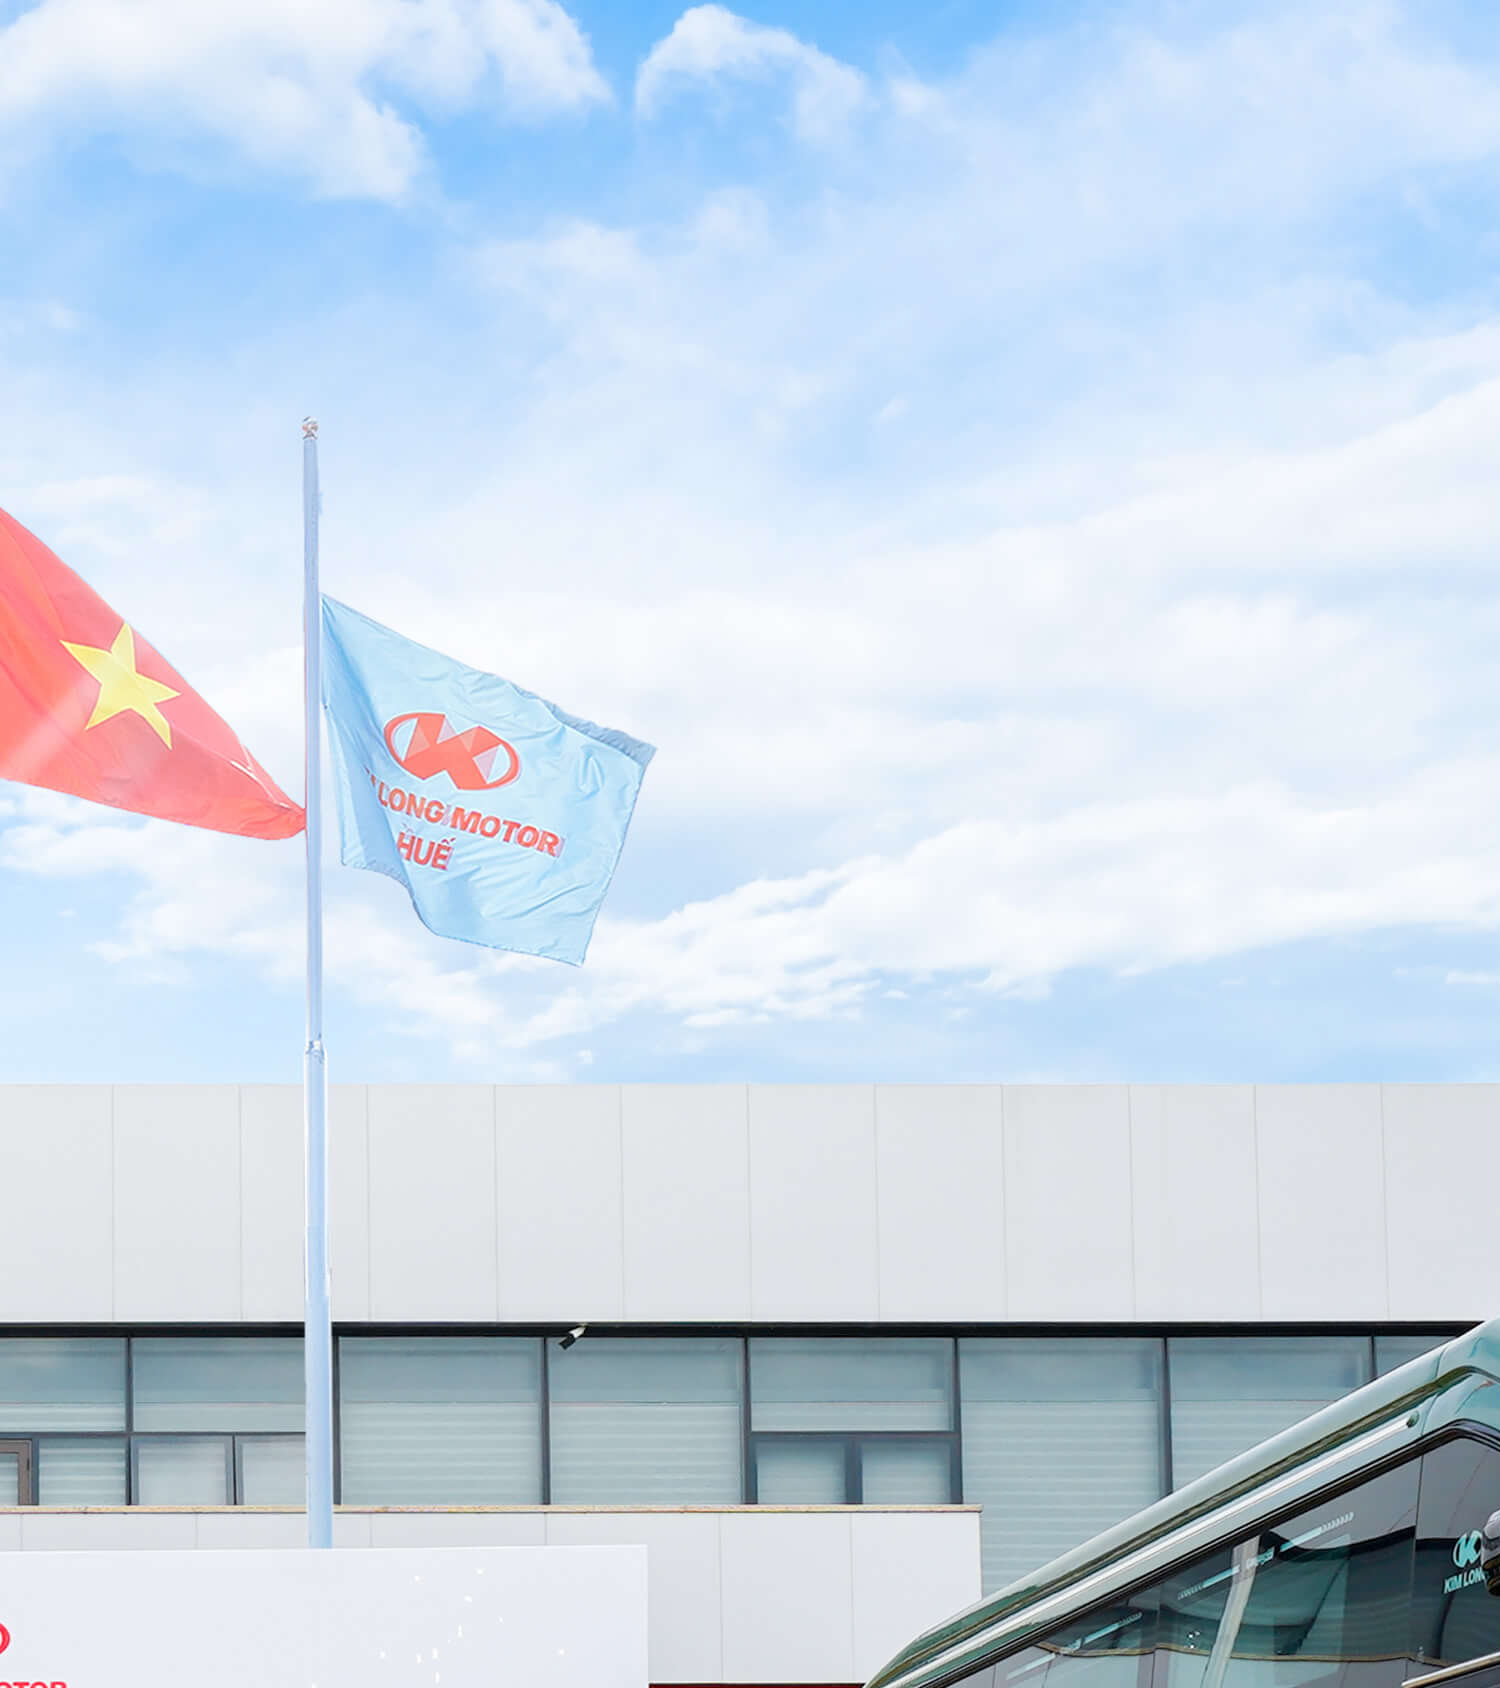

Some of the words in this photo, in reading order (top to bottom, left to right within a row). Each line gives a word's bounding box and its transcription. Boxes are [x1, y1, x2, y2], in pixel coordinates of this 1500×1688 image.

[378, 782, 444, 825] LONG
[450, 807, 561, 857] MOTOR
[397, 832, 456, 870] HUẾ
